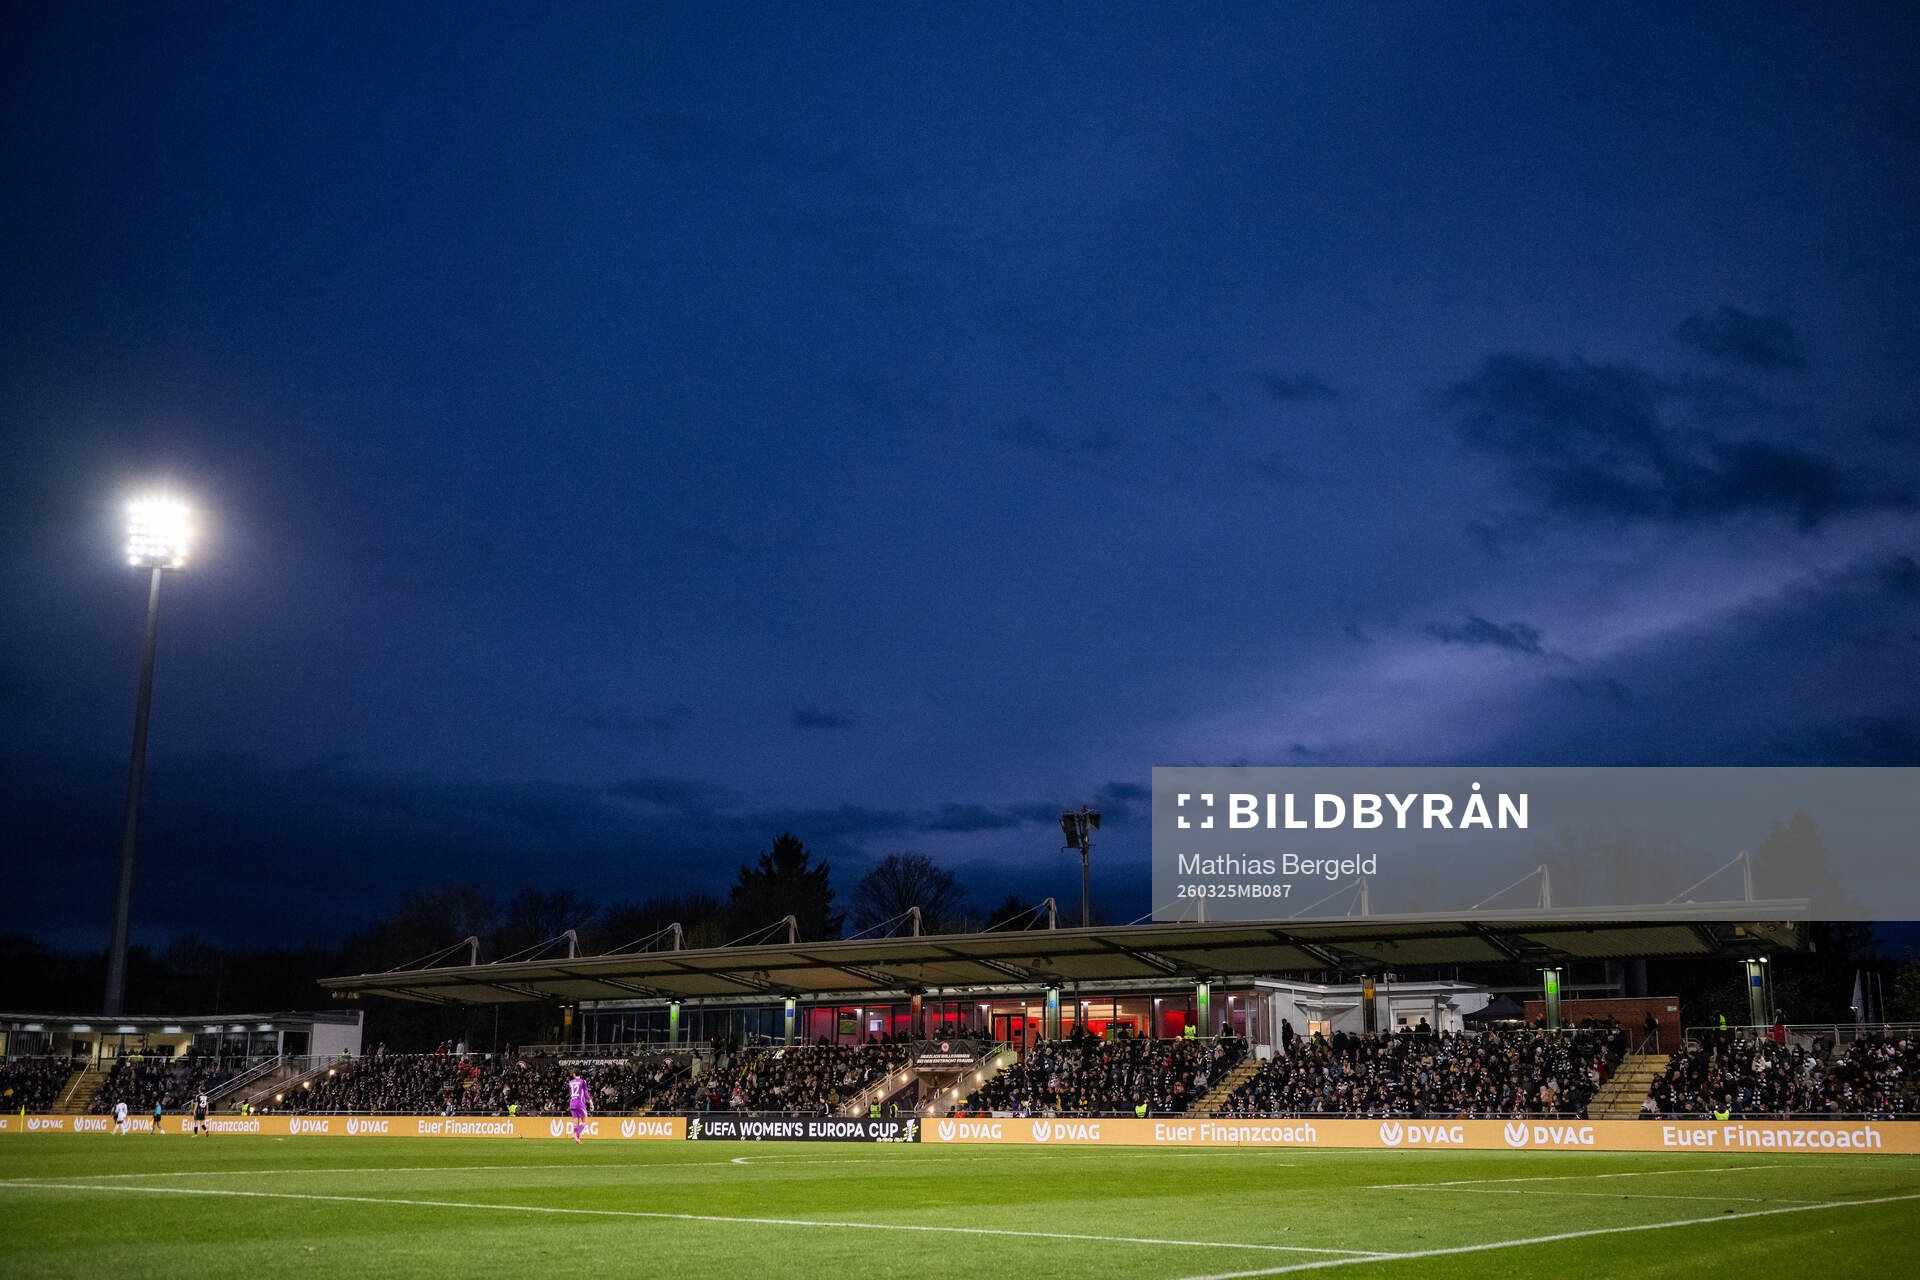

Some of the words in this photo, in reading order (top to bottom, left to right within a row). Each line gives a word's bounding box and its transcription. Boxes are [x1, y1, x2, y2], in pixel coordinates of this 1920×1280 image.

[570, 1084, 580, 1097] 12
[41, 1119, 64, 1129] DVAG
[84, 1119, 107, 1131] DVAG
[132, 1119, 152, 1131] DVA
[302, 1120, 329, 1133] DVAG
[360, 1120, 389, 1133] DVAG
[418, 1120, 442, 1134] Euer
[445, 1119, 513, 1135] Finanzcoach
[566, 1121, 599, 1135] DAG
[638, 1122, 672, 1136] DVAG
[704, 1122, 737, 1136] UEFA
[808, 1123, 865, 1137] EUROPA
[868, 1123, 899, 1138] CUP
[959, 1123, 1002, 1139] DVAG
[1054, 1124, 1100, 1140] DVAG
[1155, 1123, 1195, 1141] Euer
[1200, 1123, 1316, 1142] Finanzcoach
[1407, 1126, 1464, 1143] DVAG
[1534, 1126, 1594, 1145] DVAG
[1663, 1126, 1717, 1146] Euer
[1724, 1125, 1881, 1148] Finanzcoach
